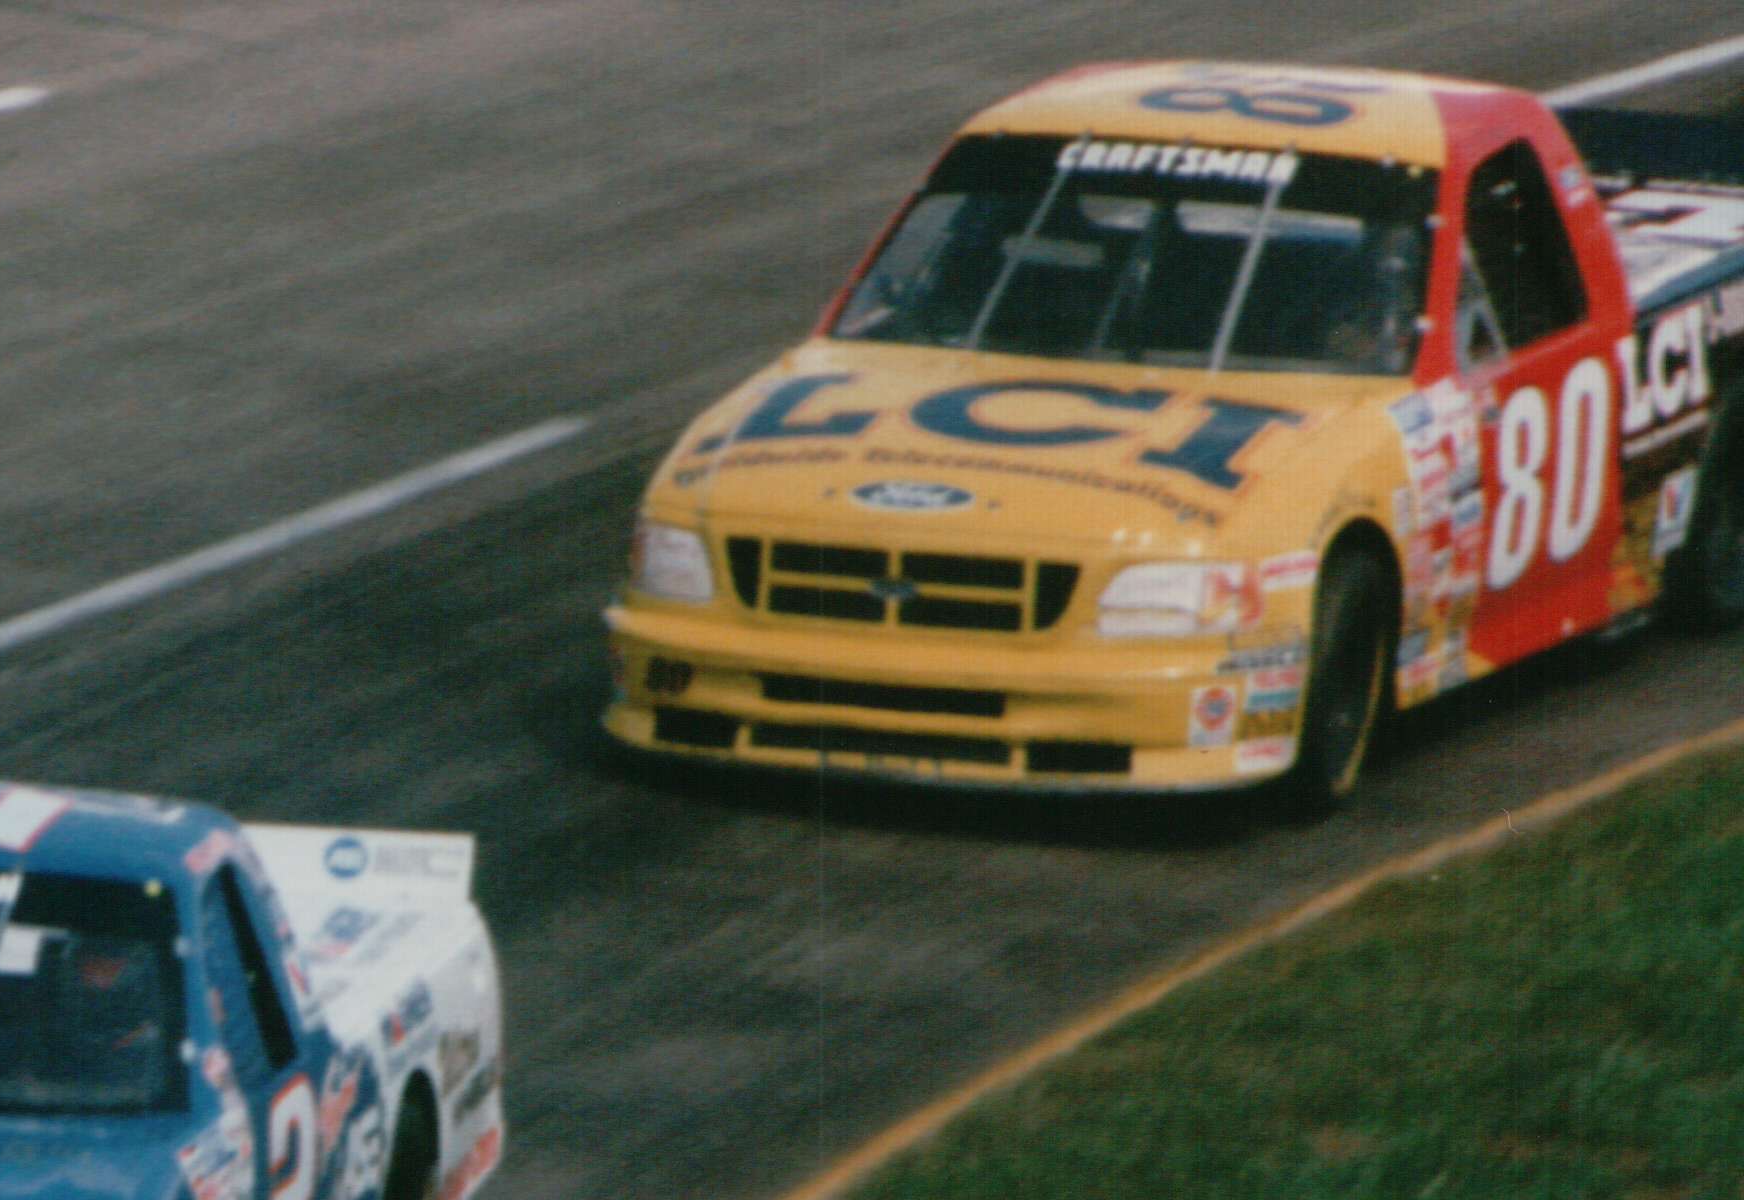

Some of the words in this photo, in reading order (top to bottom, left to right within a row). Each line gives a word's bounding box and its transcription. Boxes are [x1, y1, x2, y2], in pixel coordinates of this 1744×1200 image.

[1056, 141, 1302, 186] CRAFTSMAN
[694, 372, 1306, 491] LCI
[1616, 305, 1711, 436] LCI
[1487, 357, 1612, 592] 80
